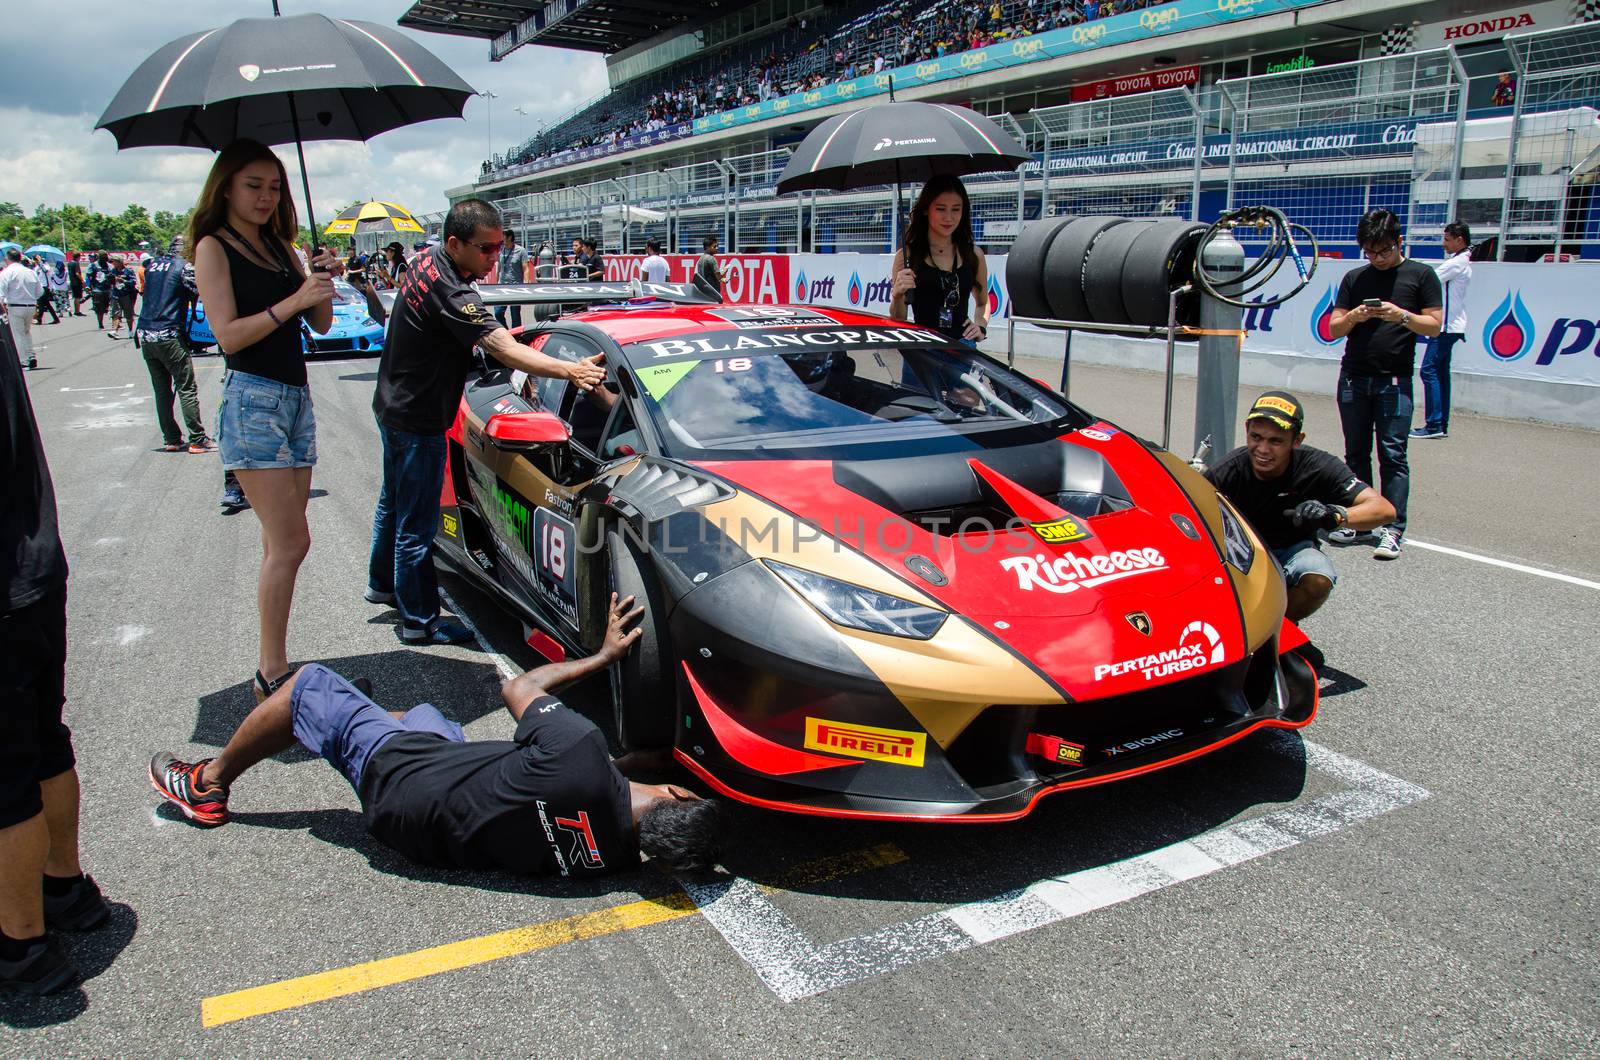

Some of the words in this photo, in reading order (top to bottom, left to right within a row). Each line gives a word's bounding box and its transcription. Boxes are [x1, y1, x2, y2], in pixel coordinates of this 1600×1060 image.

[1140, 7, 1179, 30] Open
[1444, 14, 1535, 40] HONDA
[1072, 24, 1106, 45] Open
[1013, 39, 1043, 57] Open
[961, 52, 987, 68] Open
[916, 63, 940, 80] Open
[1115, 76, 1151, 92] TOYOTA
[1157, 69, 1196, 86] TOYOTA
[804, 92, 821, 103] Open
[837, 83, 856, 96] Open
[895, 137, 937, 146] PERTAMINA
[1303, 134, 1357, 151] CIRCUIT
[1382, 125, 1416, 145] Cha
[1048, 155, 1107, 171] TERNATIONAL
[1111, 151, 1149, 165] CIRCUIT
[1158, 199, 1176, 213] 14
[149, 262, 172, 272] 241
[681, 258, 778, 305] TOTA
[809, 275, 835, 303] ptt
[864, 276, 893, 307] ptt
[735, 305, 798, 317] 18
[1242, 293, 1281, 333] tt
[741, 318, 831, 327] BLANCPAIN
[648, 328, 948, 359] BLANCPAIN
[653, 367, 672, 377] AM
[713, 357, 753, 375] 18
[544, 487, 574, 514] Fastron
[443, 517, 457, 533] OMP
[1035, 522, 1078, 539] OMP
[542, 520, 566, 581] 18
[1000, 547, 1168, 593] Richeese
[1094, 643, 1203, 681] PERTAMAX
[1142, 655, 1207, 681] TURBO
[817, 725, 915, 758] PIRELLI
[1123, 728, 1184, 750] BIONIC
[1059, 747, 1081, 760] OMP
[536, 800, 554, 842] tedco
